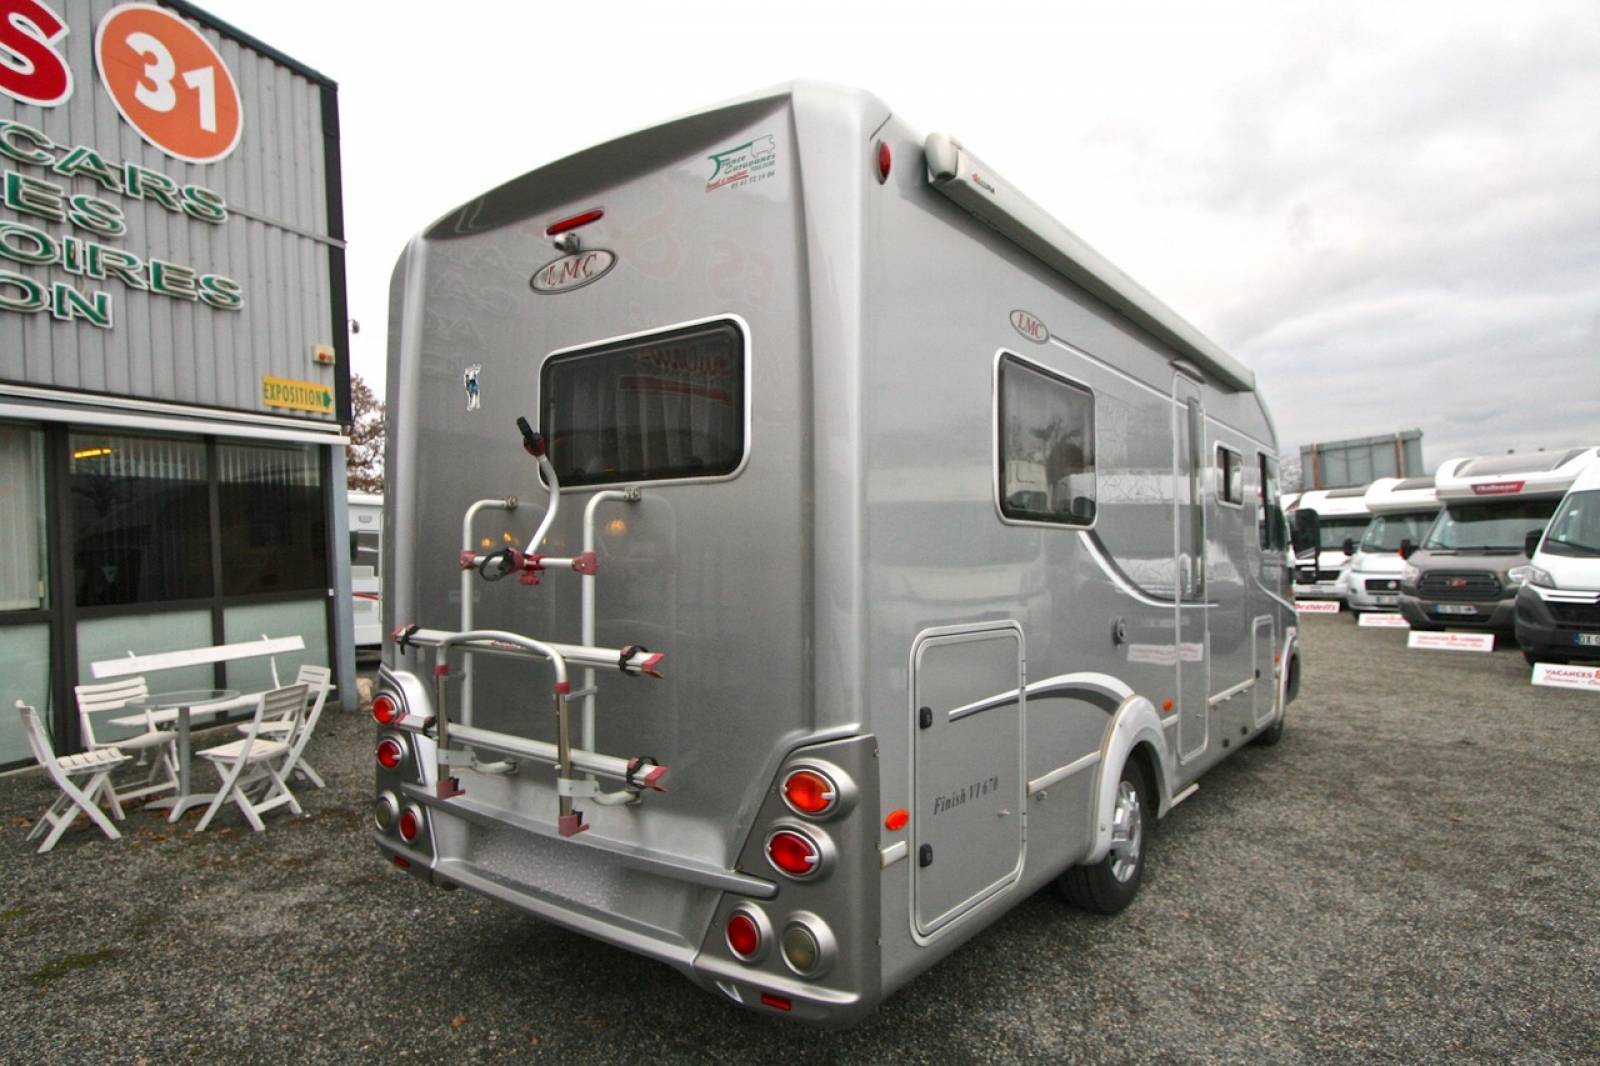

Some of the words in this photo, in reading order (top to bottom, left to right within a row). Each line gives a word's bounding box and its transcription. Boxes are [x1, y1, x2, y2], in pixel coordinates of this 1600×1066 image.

[125, 31, 217, 134] 31
[0, 118, 229, 225] CARS
[4, 169, 127, 236] ES
[0, 220, 245, 311] OIRES
[546, 252, 598, 286] LMC
[0, 268, 113, 328] ON
[1018, 312, 1042, 339] LMC
[263, 381, 322, 407] EXPOSITION
[933, 787, 966, 815] Finish
